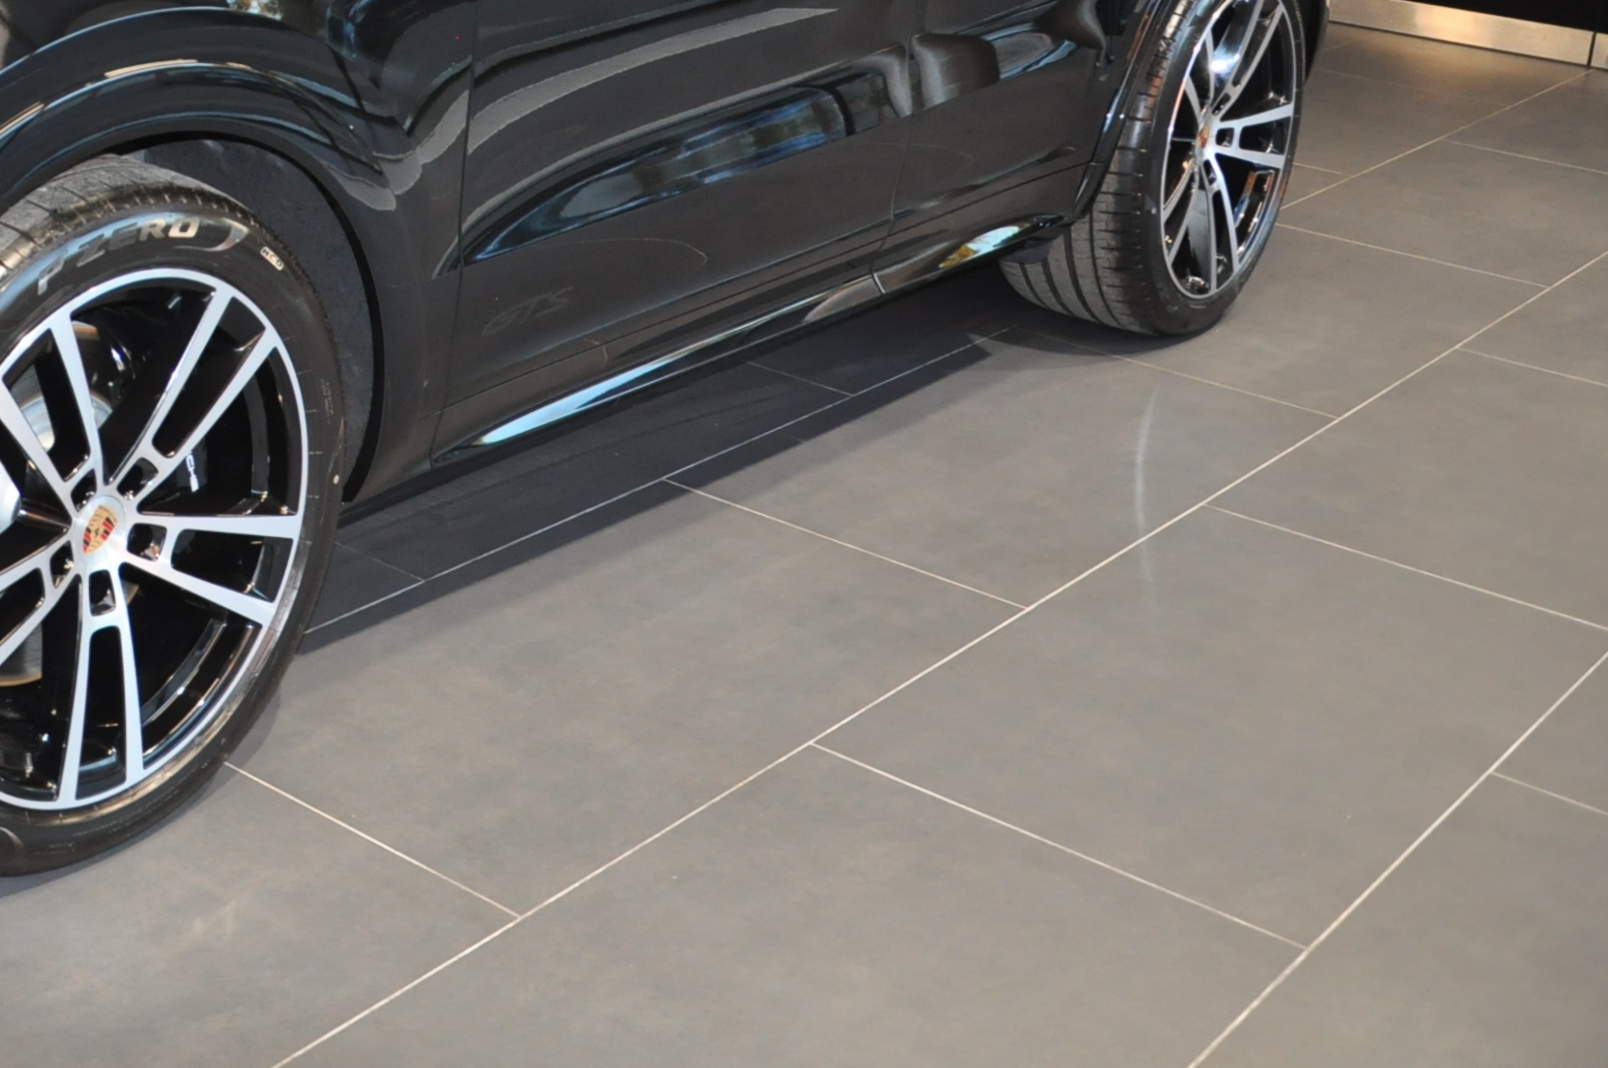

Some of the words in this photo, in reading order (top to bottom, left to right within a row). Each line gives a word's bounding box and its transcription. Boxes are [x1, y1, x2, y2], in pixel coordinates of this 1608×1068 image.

[37, 248, 68, 295] P
[76, 217, 199, 267] ZERO
[481, 286, 574, 336] GTS
